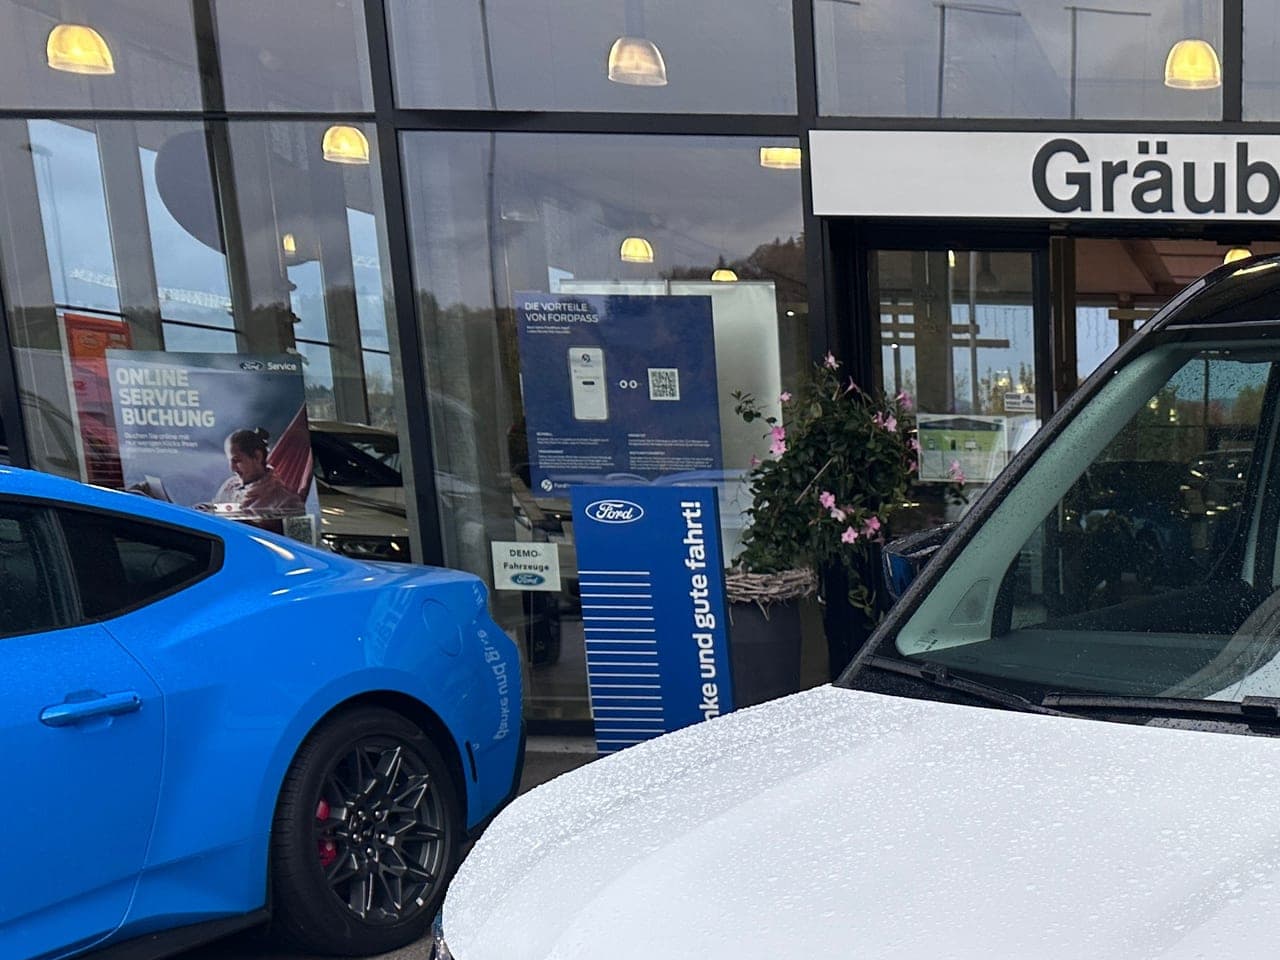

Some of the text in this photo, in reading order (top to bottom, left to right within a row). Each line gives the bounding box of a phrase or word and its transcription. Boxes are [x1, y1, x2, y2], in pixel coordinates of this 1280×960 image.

[1032, 138, 1280, 215] Gräub
[524, 302, 588, 312] DIE VORTEILE
[525, 313, 599, 323] VON FORDPASS
[267, 361, 297, 371] Service
[116, 368, 189, 387] ONLINE
[119, 388, 200, 407] SERVICE
[122, 408, 215, 428] BUCHUNG
[596, 503, 633, 520] Ford
[509, 549, 542, 558] DEMO-
[503, 561, 550, 572] Fahrzeuge
[680, 501, 720, 721] nke und gute fahrt!
